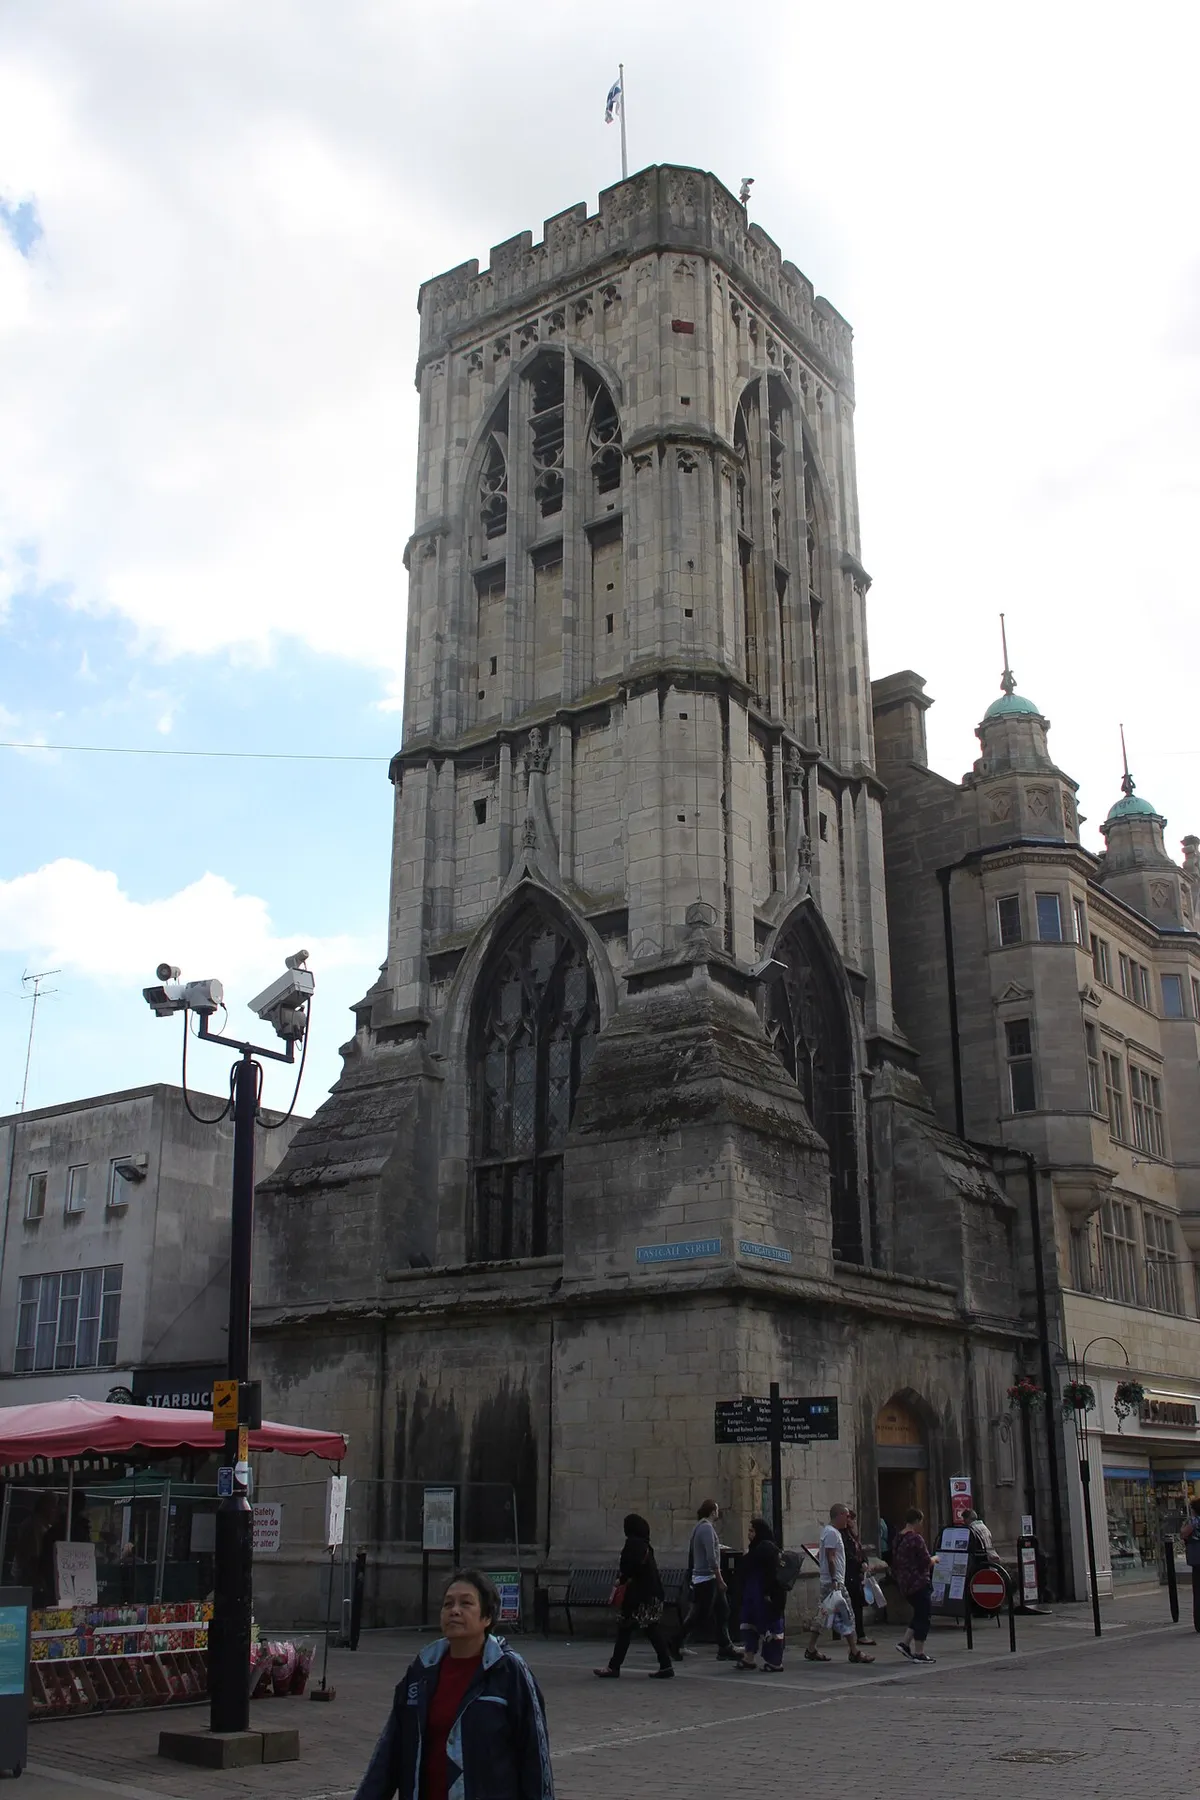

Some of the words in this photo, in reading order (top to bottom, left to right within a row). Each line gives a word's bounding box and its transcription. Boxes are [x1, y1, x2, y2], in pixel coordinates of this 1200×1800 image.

[638, 1245, 680, 1259] EASTGATE
[685, 1242, 716, 1254] STREET
[741, 1242, 771, 1256] SOUTHGATE
[772, 1250, 790, 1261] STREET
[146, 1392, 214, 1407] STARBUC
[254, 1508, 275, 1517] Safety
[260, 1540, 275, 1548] alter
